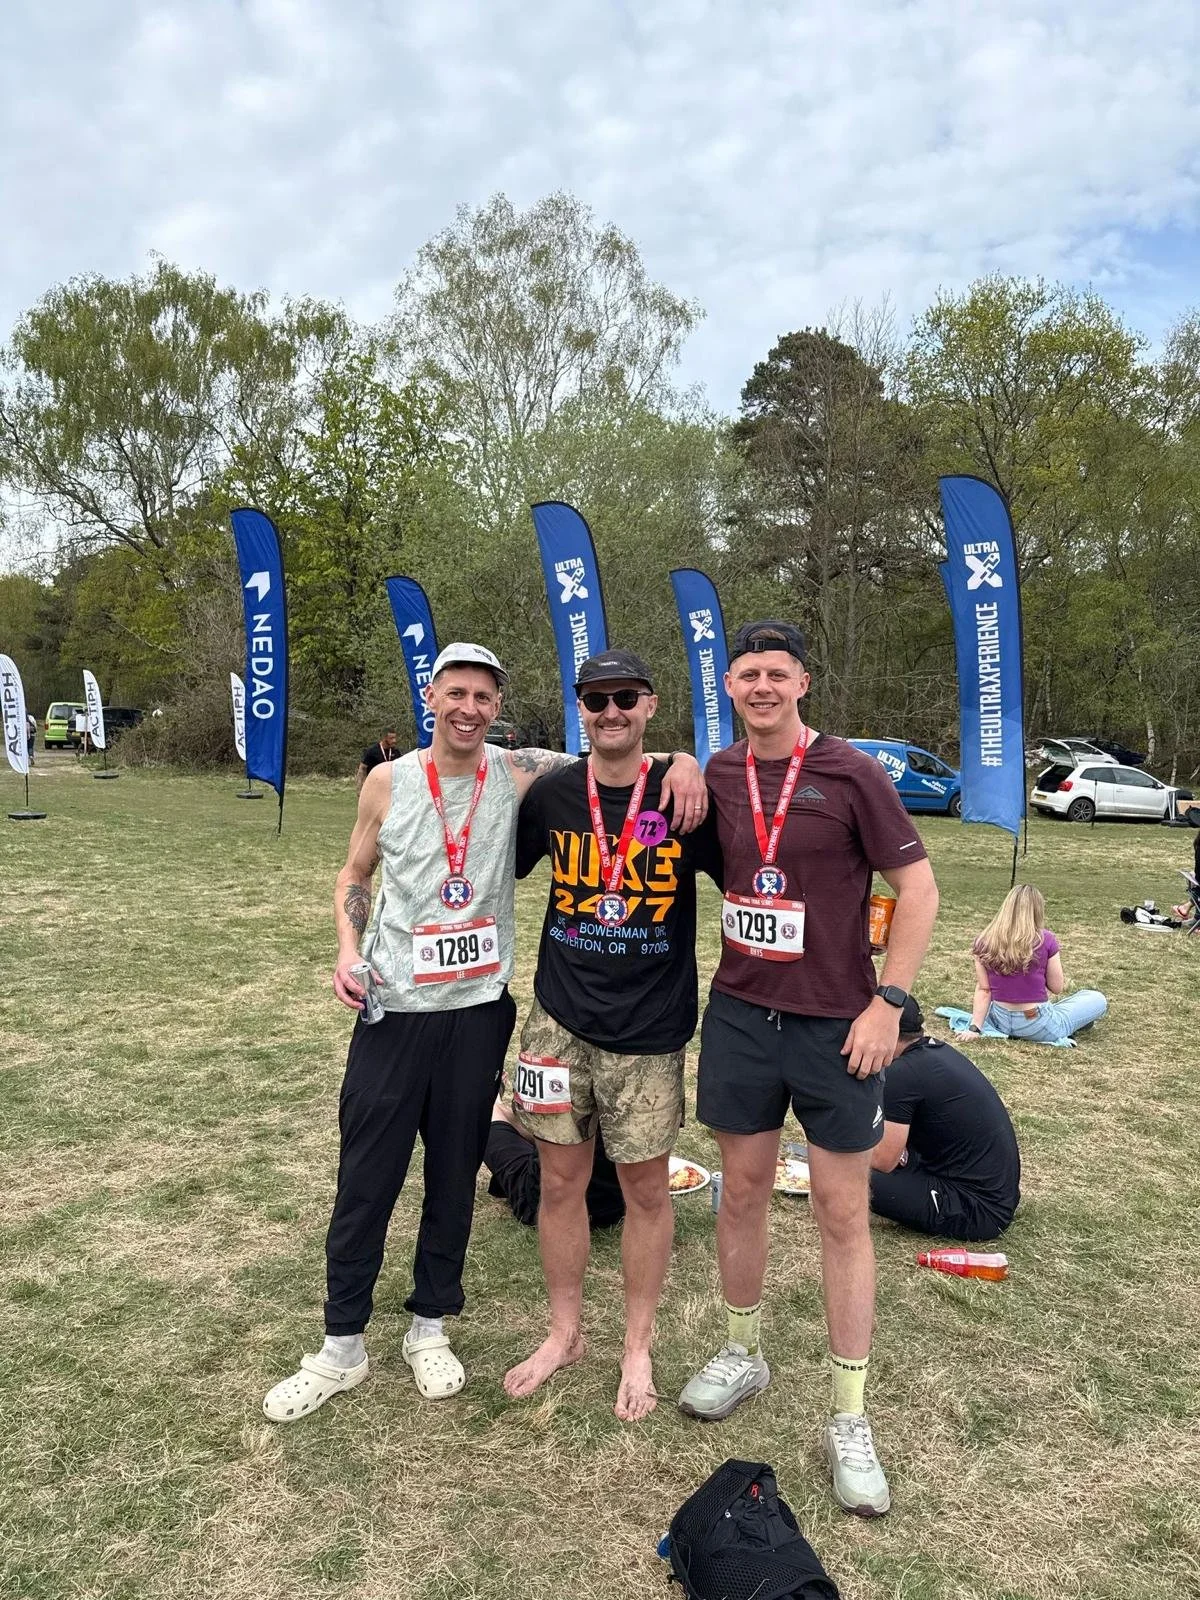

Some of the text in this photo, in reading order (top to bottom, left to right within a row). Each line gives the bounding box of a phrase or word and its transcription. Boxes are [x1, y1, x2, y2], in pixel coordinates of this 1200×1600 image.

[963, 541, 1000, 555] ULTRA
[554, 557, 585, 574] ULTRA
[688, 608, 712, 620] ULTRA
[251, 613, 275, 720] NEDAO
[975, 601, 1003, 767] #THEULTRAXPERIENCE
[876, 750, 907, 773] ULTRA
[787, 767, 798, 784] SERIES
[598, 838, 609, 855] SERIES
[549, 829, 682, 892] NIKE
[579, 922, 648, 940] BOWERMAN
[736, 909, 777, 944] 1293
[435, 933, 480, 967] 1289
[608, 942, 627, 955] OR
[640, 940, 670, 955] 97005
[456, 971, 466, 979] LEE
[517, 1065, 544, 1099] 1291
